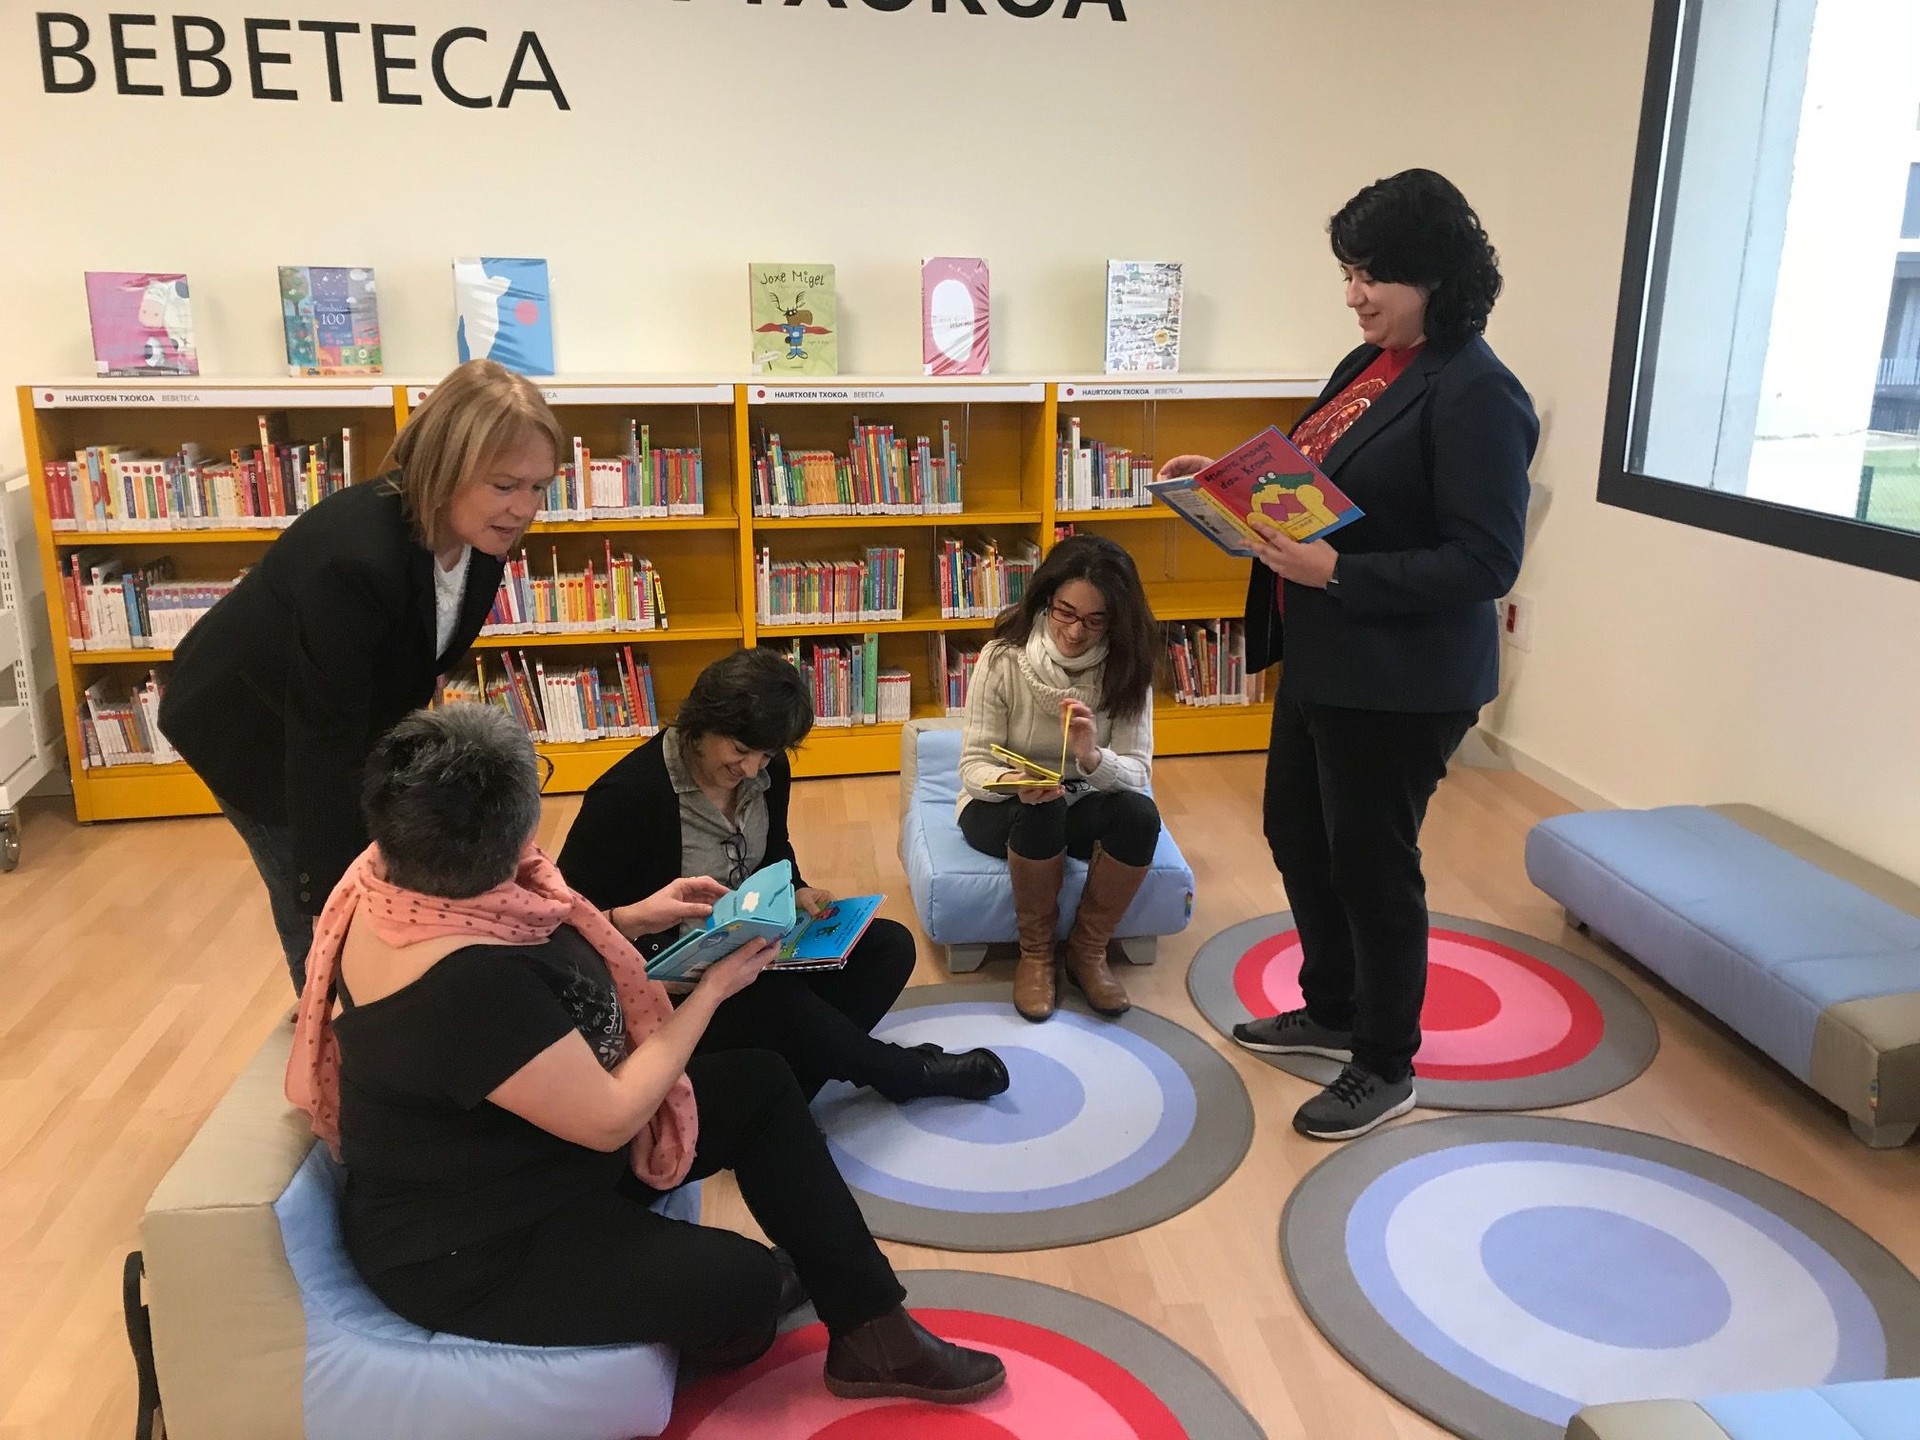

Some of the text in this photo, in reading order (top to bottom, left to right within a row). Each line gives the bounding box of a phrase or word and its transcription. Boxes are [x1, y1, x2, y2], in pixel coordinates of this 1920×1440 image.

[36, 11, 571, 111] BEBETECA
[760, 270, 825, 288] Joxe Migel
[321, 313, 346, 325] 100
[65, 394, 200, 402] HAURTXOEN TXOKOA BEBETECA
[775, 391, 885, 399] HAURTXOEN TXOKOA BEBETECA
